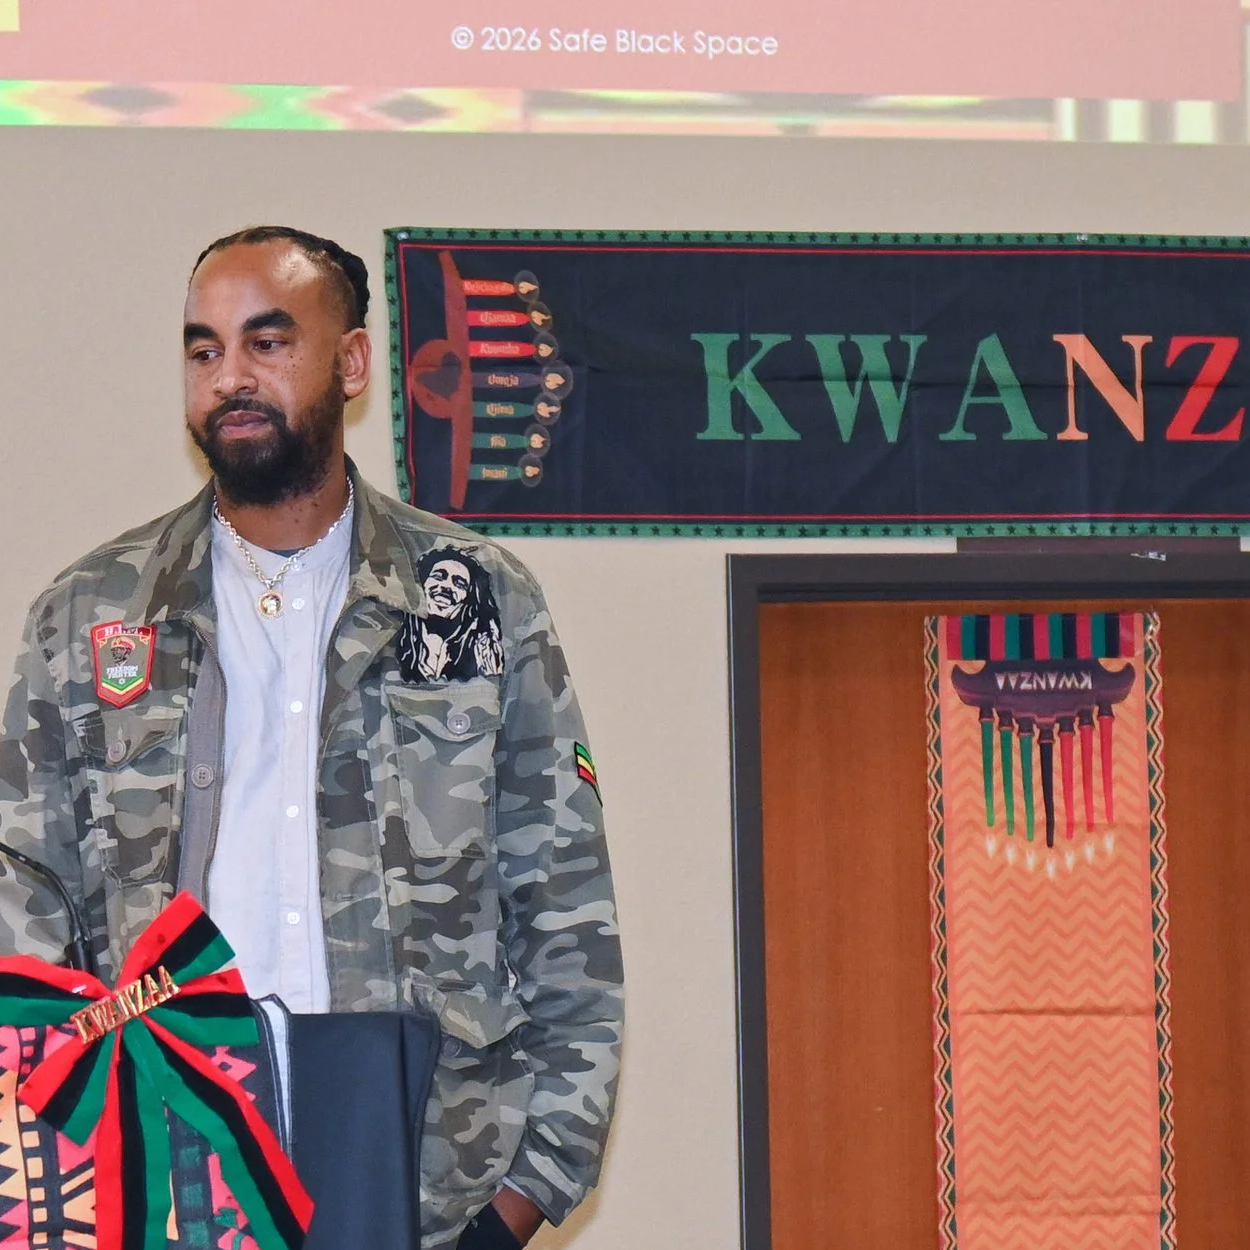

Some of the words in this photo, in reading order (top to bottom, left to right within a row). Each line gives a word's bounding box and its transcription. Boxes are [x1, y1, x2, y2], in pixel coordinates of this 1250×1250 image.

[480, 26, 542, 53] 2026
[549, 27, 608, 54] Safe
[616, 29, 686, 55] Black
[693, 30, 779, 60] Space
[690, 332, 1246, 443] KWANZ
[995, 671, 1093, 691] KWANZAA
[70, 965, 181, 1045] KWANZAA
